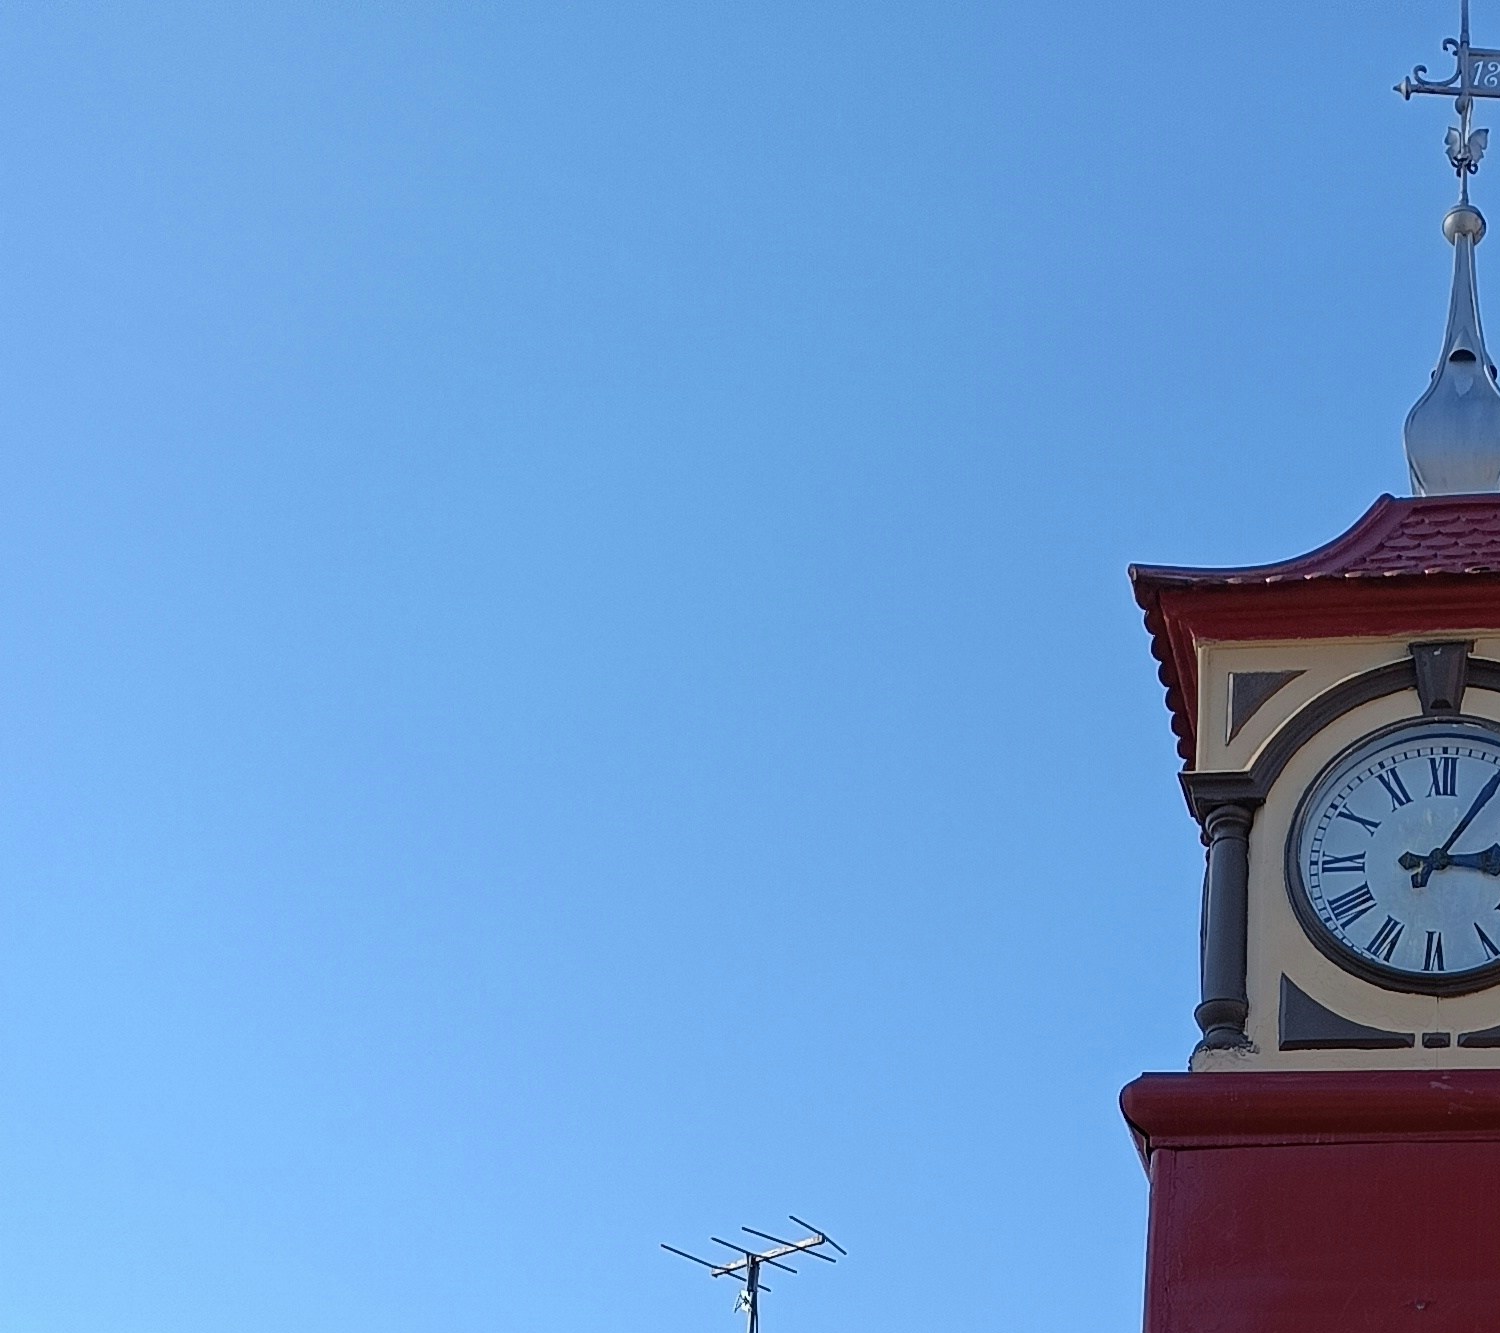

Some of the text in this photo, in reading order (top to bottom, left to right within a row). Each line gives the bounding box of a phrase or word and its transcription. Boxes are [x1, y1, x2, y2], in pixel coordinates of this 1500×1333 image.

[1376, 766, 1413, 812] XI
[1427, 757, 1459, 797] XII
[1337, 802, 1381, 837] X
[1322, 850, 1366, 874] IX
[1422, 931, 1445, 972] VI
